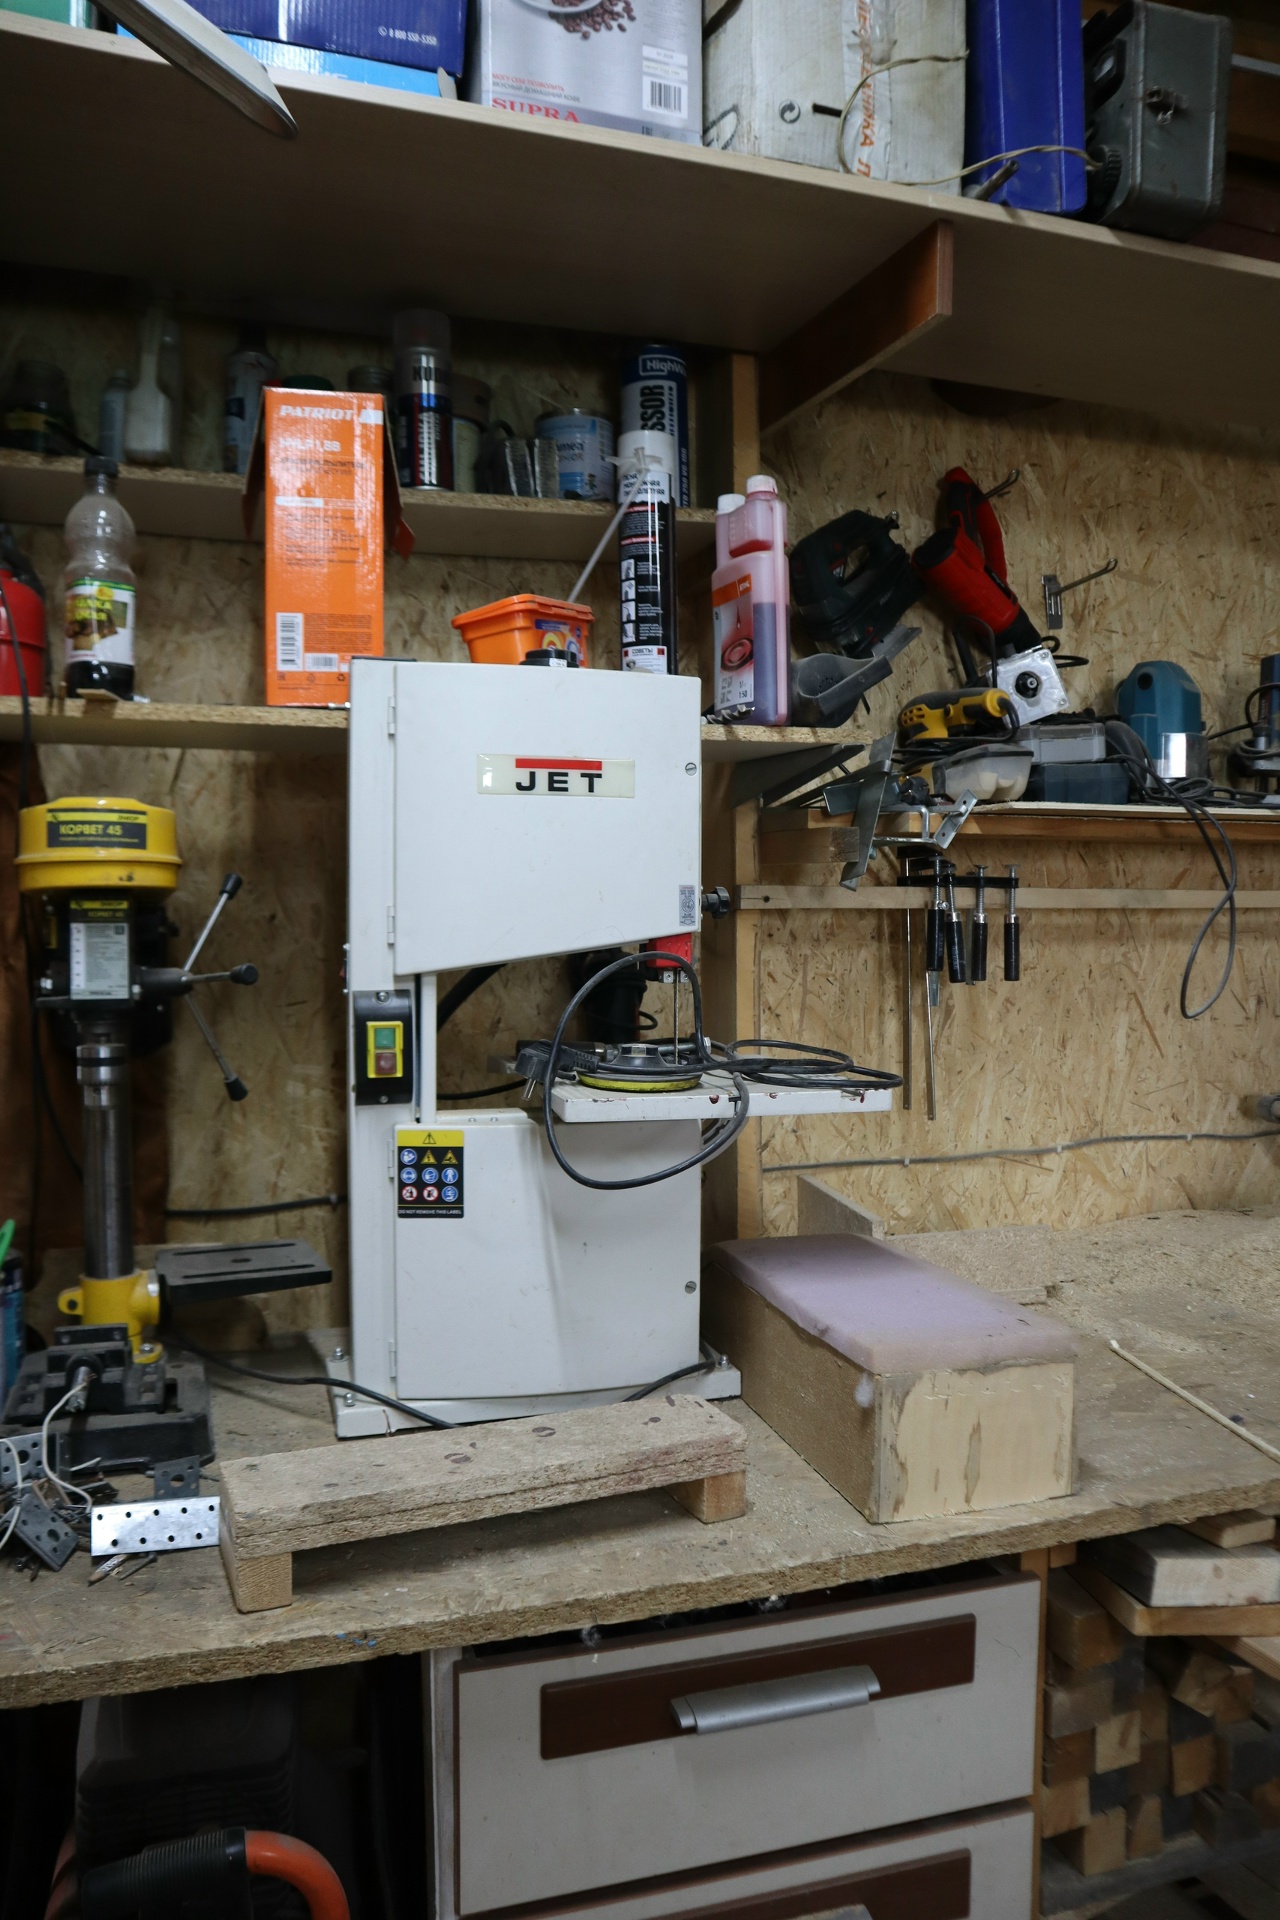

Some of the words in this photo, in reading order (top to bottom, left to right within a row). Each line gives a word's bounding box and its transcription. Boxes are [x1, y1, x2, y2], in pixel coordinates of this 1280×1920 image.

[492, 97, 579, 124] SUPRA
[280, 405, 354, 421] PATRIOT
[640, 385, 665, 432] SSOR
[516, 771, 602, 793] JET
[60, 824, 104, 835] КОРВЕТ
[106, 825, 123, 836] 45
